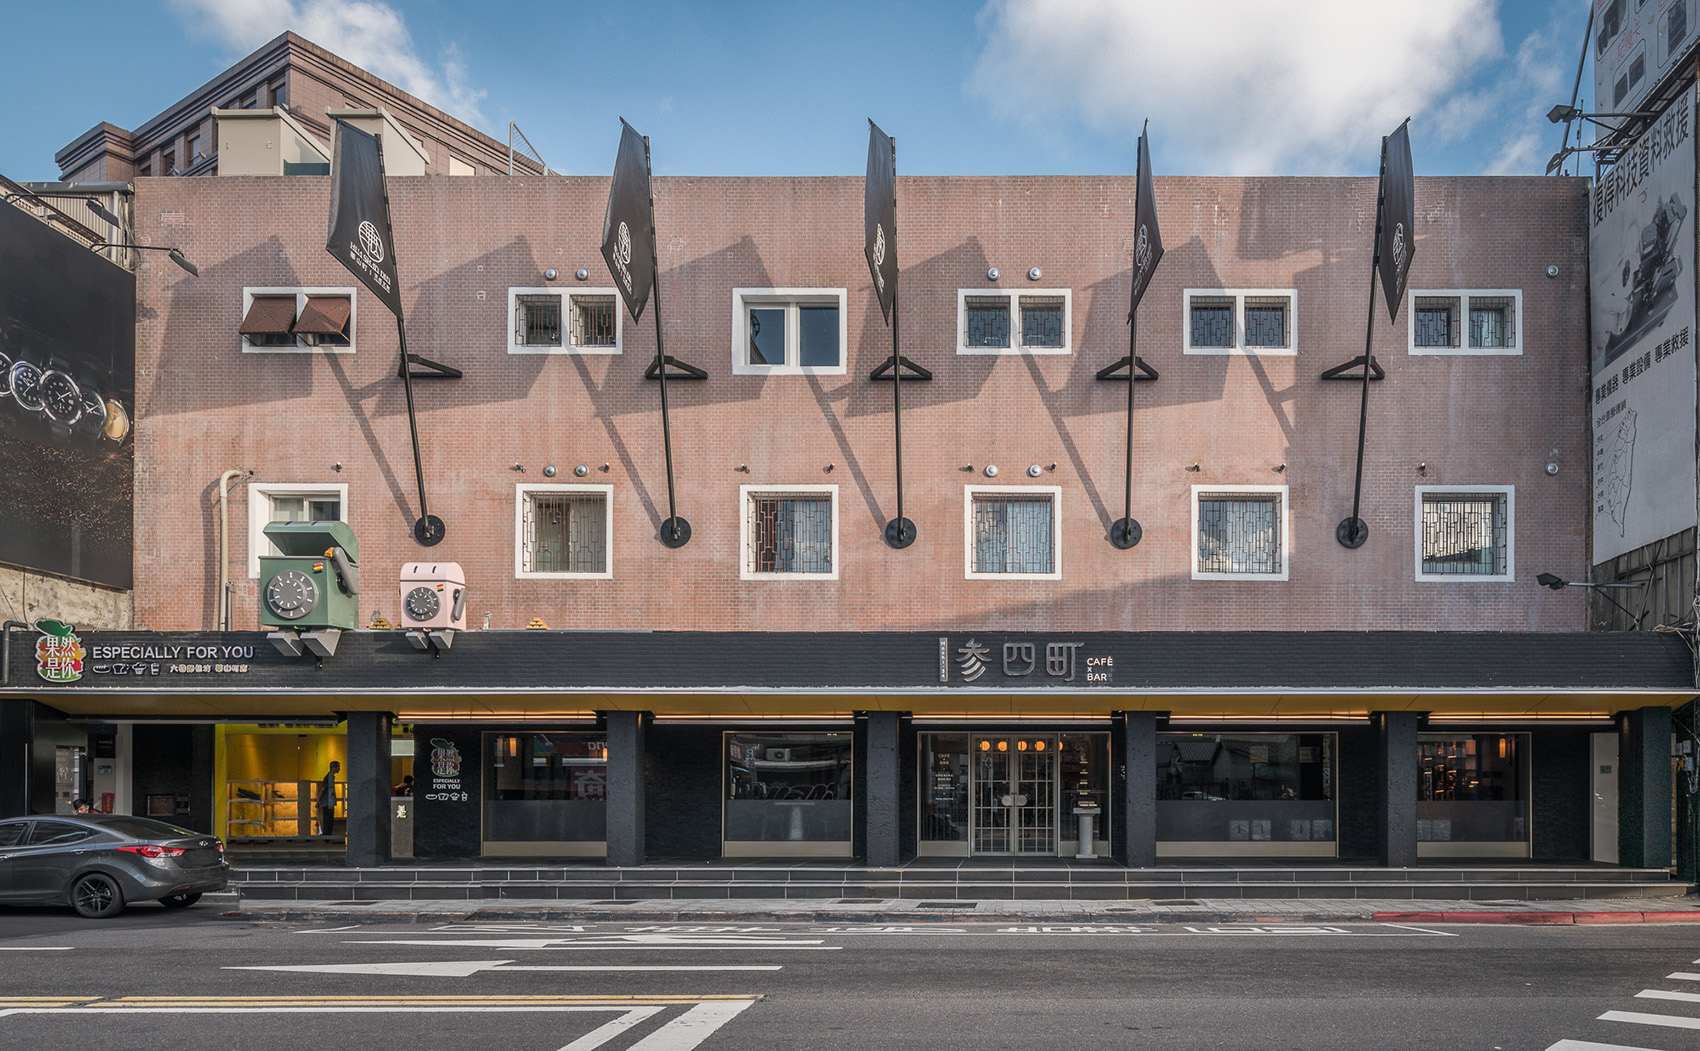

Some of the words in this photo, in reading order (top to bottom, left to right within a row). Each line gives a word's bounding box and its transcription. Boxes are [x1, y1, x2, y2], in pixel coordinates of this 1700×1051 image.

[45, 636, 76, 657] 果然
[93, 646, 181, 659] ESPECIALLY
[187, 646, 218, 659] FOR
[222, 646, 254, 659] YOU
[46, 657, 76, 679] 是你
[1086, 656, 1113, 666] CAFÉ
